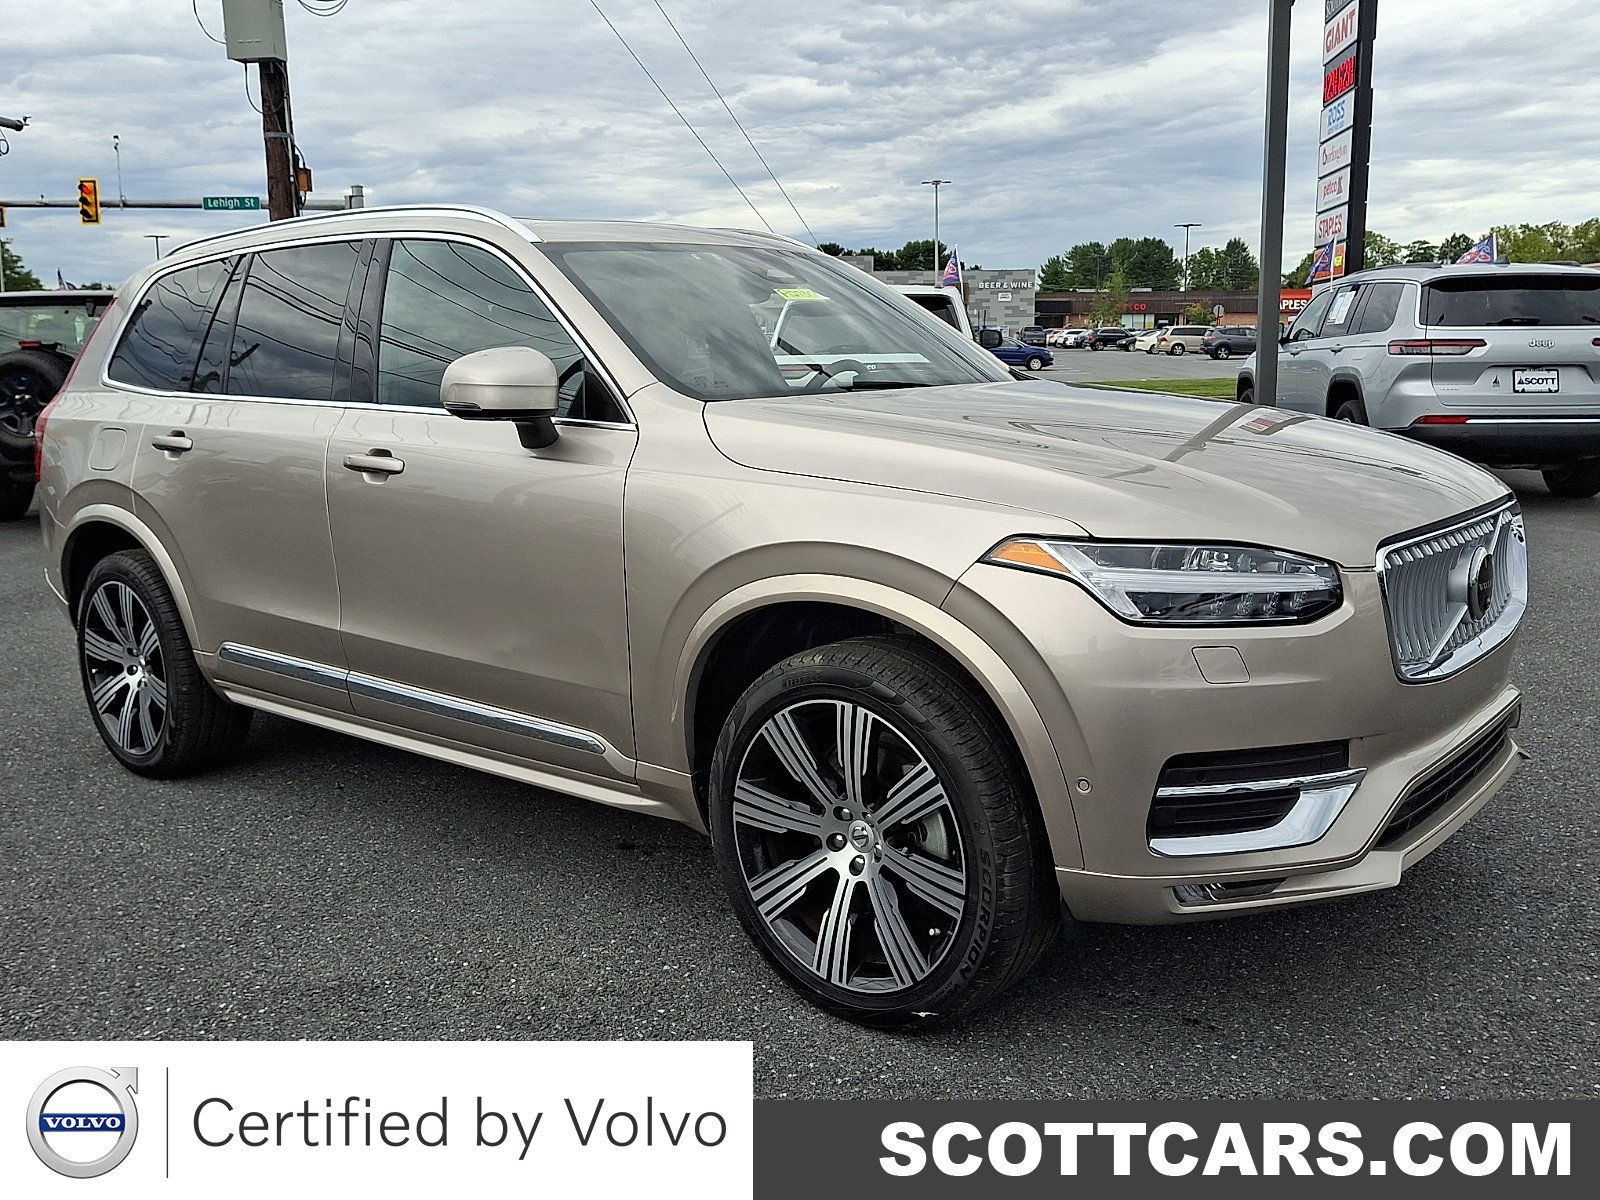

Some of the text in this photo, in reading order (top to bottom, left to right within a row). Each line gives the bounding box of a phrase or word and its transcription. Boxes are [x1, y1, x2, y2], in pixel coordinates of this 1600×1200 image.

[1325, 8, 1356, 53] GIANT
[207, 197, 255, 209] Lehigh St
[1318, 212, 1343, 239] STAPLES
[978, 281, 1033, 289] BEER & WINE
[1280, 299, 1308, 310] PLES
[1528, 338, 1555, 348] Jeep
[1524, 377, 1556, 385] SCOTT
